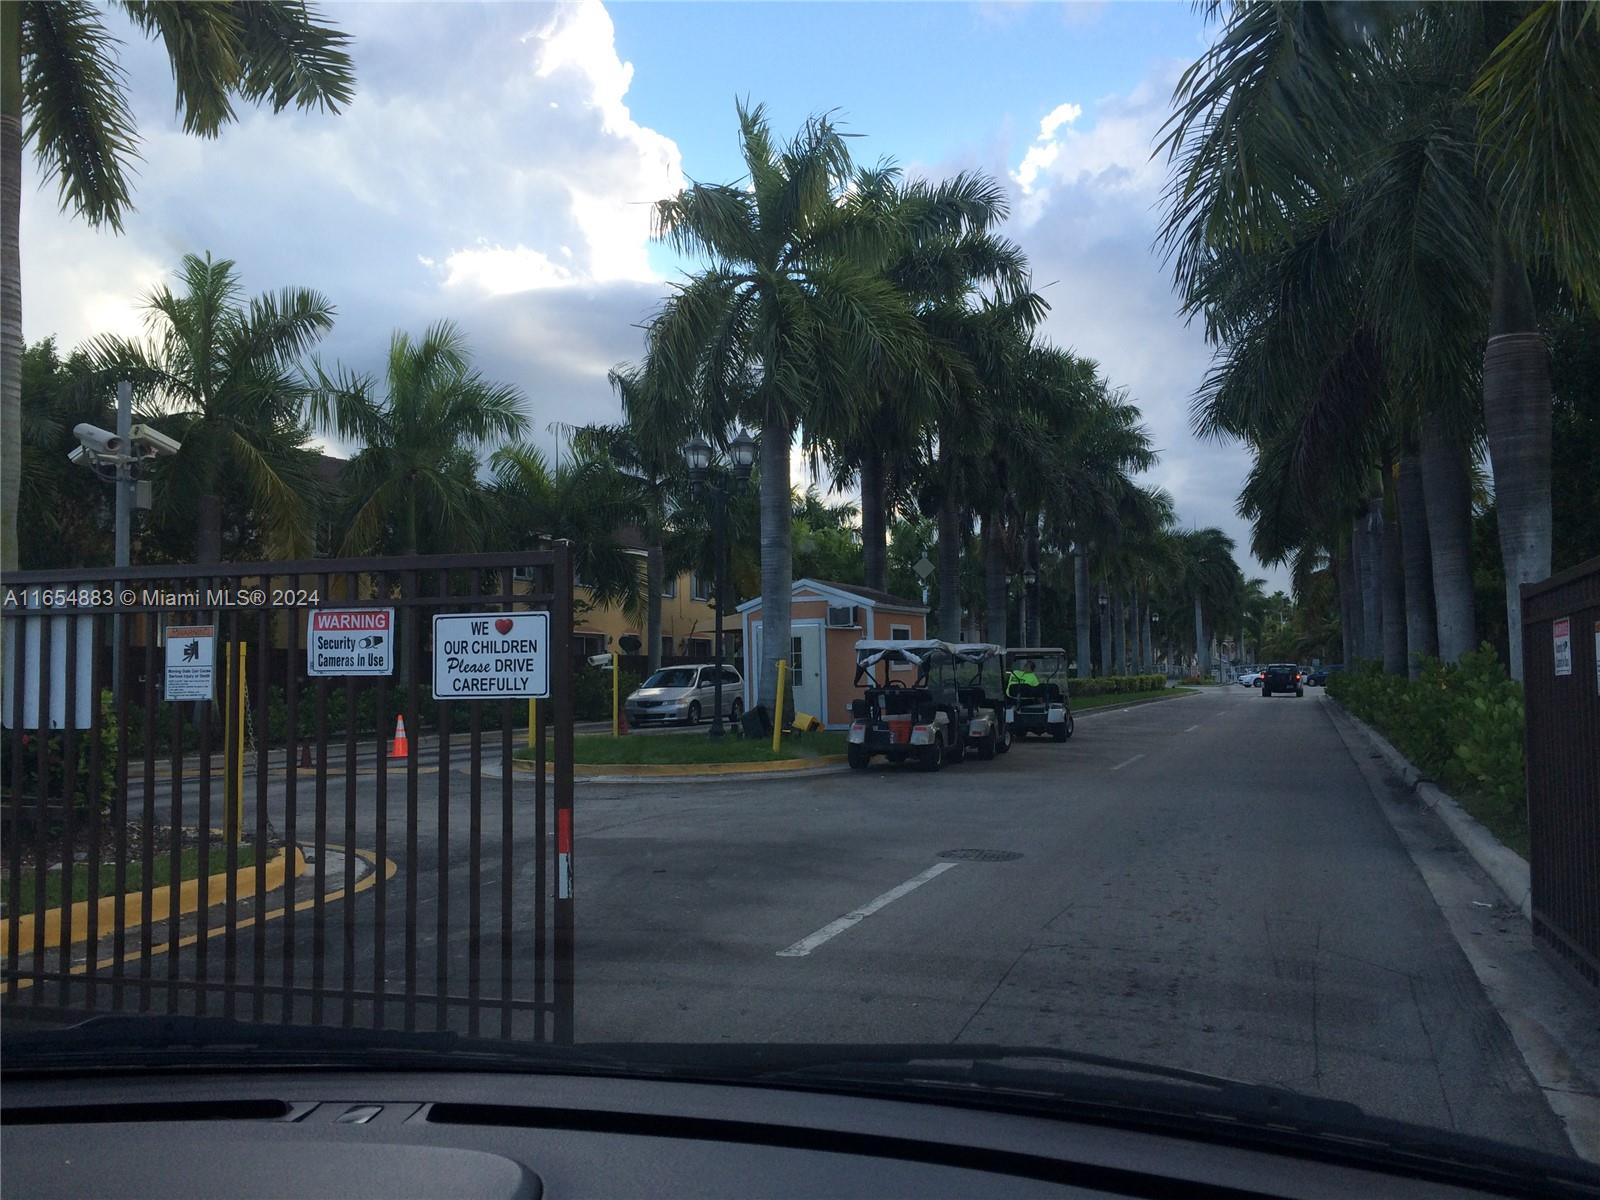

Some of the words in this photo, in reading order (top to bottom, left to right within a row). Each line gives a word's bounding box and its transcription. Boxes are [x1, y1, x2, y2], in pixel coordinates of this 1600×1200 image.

[318, 614, 386, 629] WARNING
[471, 621, 489, 636] WE
[317, 636, 356, 652] Security
[444, 640, 469, 655] OUR
[471, 639, 538, 654] CHILDREN
[317, 653, 355, 667] Cameras
[357, 653, 365, 667] In
[367, 653, 384, 667] Use
[446, 657, 491, 674] Please
[495, 658, 534, 672] DRIVE
[452, 677, 529, 692] CAREFULLY
